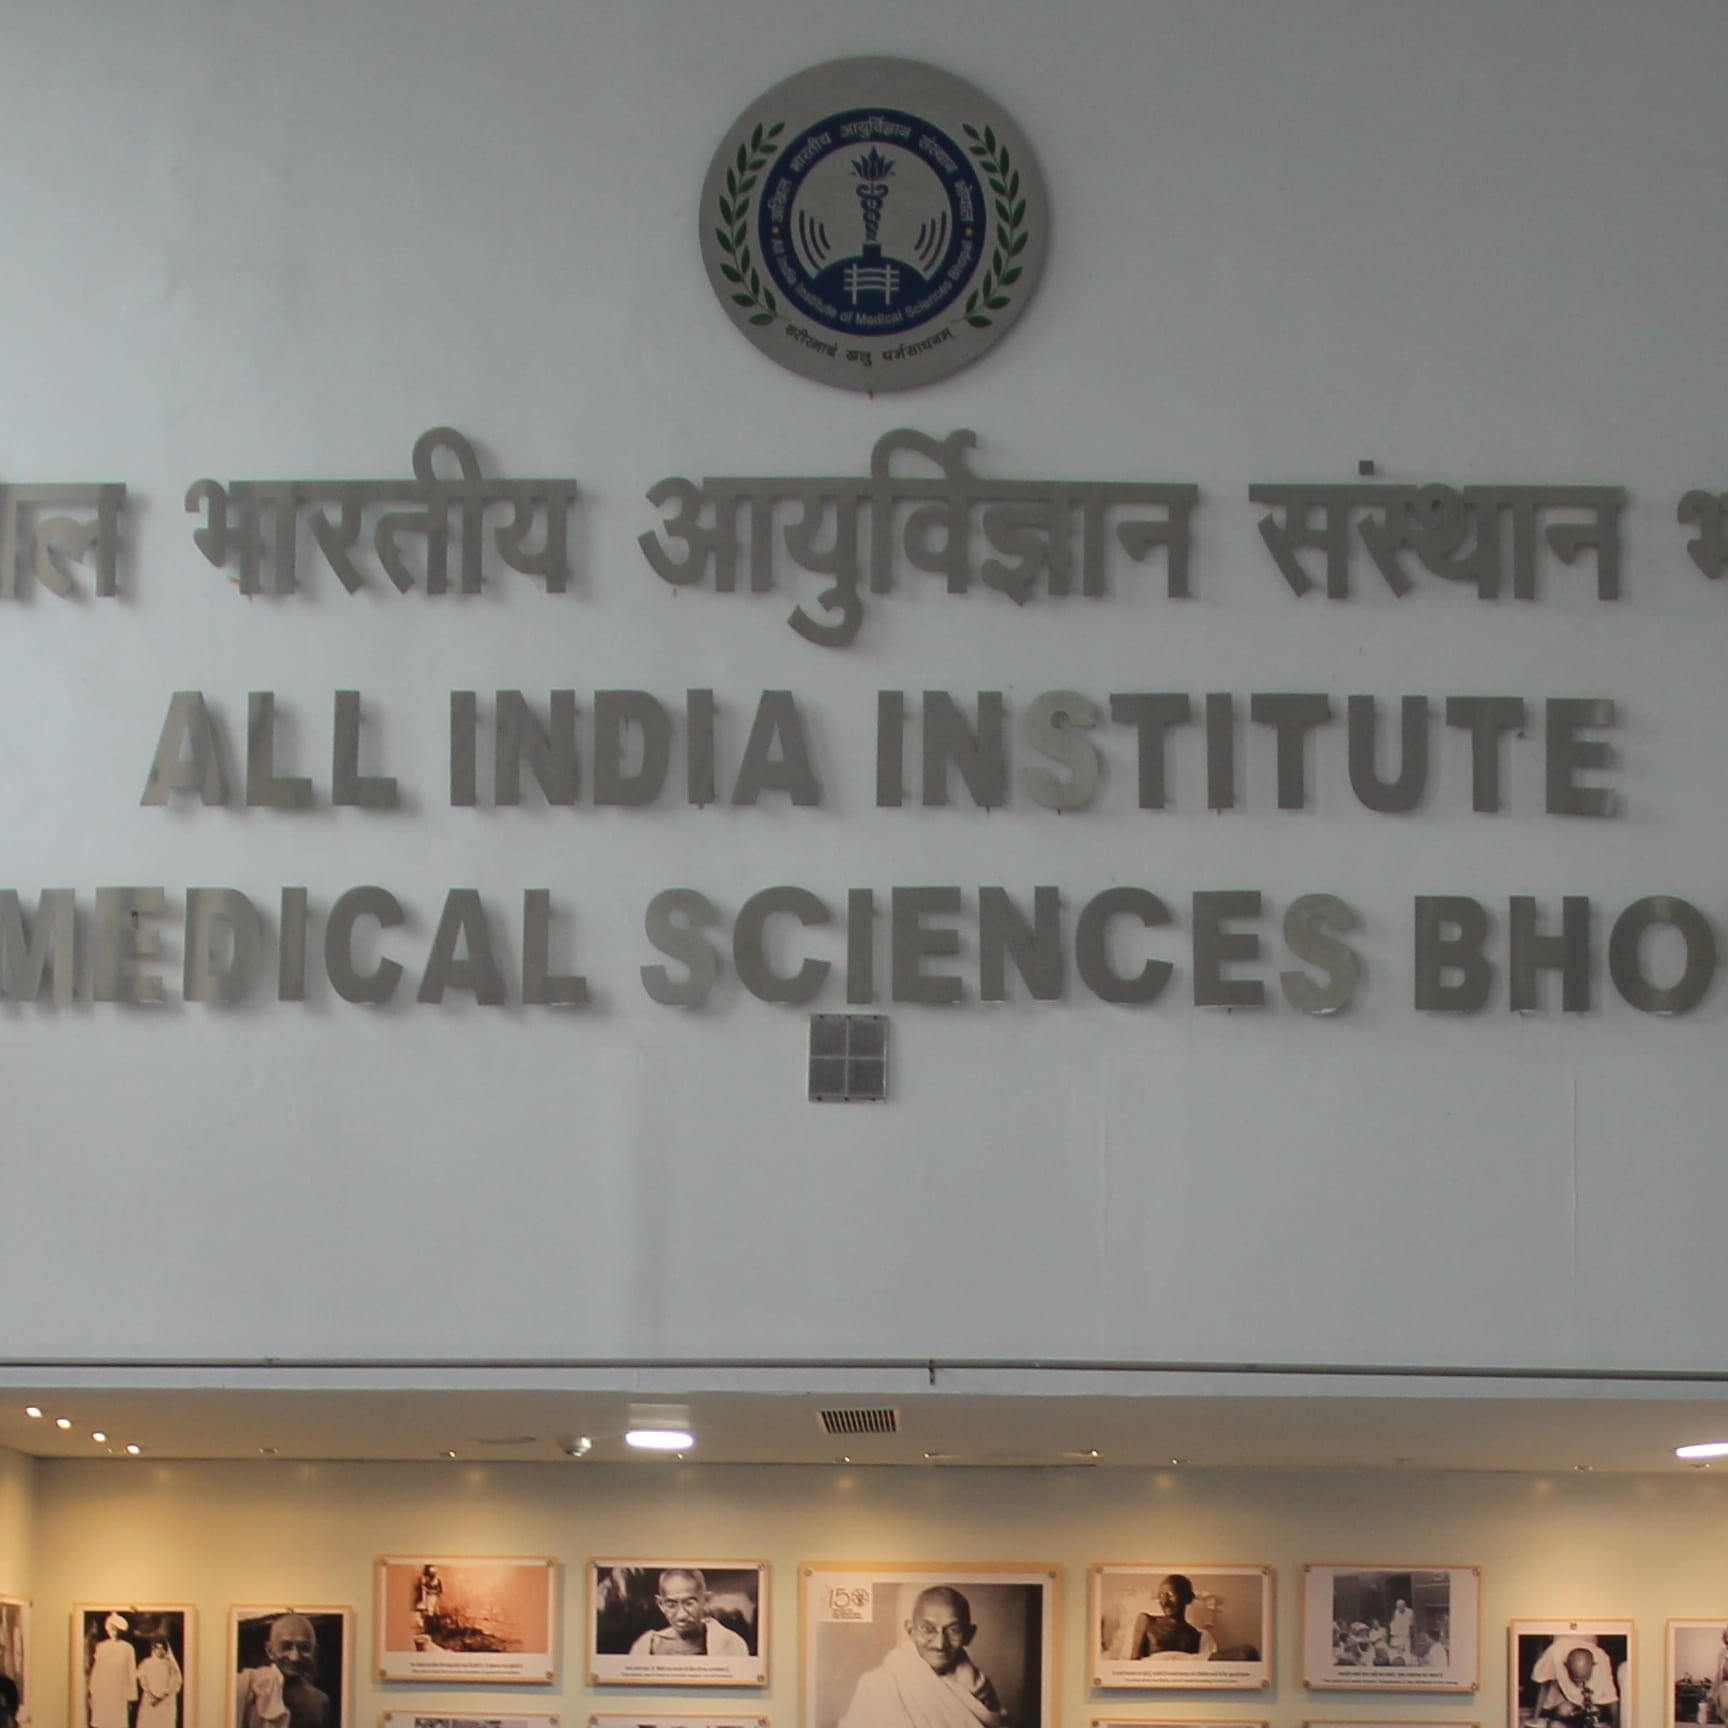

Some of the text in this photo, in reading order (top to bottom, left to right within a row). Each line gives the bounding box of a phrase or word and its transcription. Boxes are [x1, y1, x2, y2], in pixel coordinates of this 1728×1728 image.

[840, 311, 852, 324] of
[855, 309, 903, 326] Medical
[905, 280, 955, 318] Sciences
[185, 428, 577, 598] भारतीय
[638, 427, 1198, 648] आयुर्विज्ञान
[1248, 460, 1626, 600] संस्थान
[140, 688, 1615, 817] ALL INDIA INSTITUTE
[640, 886, 1356, 1015] SCIENCES
